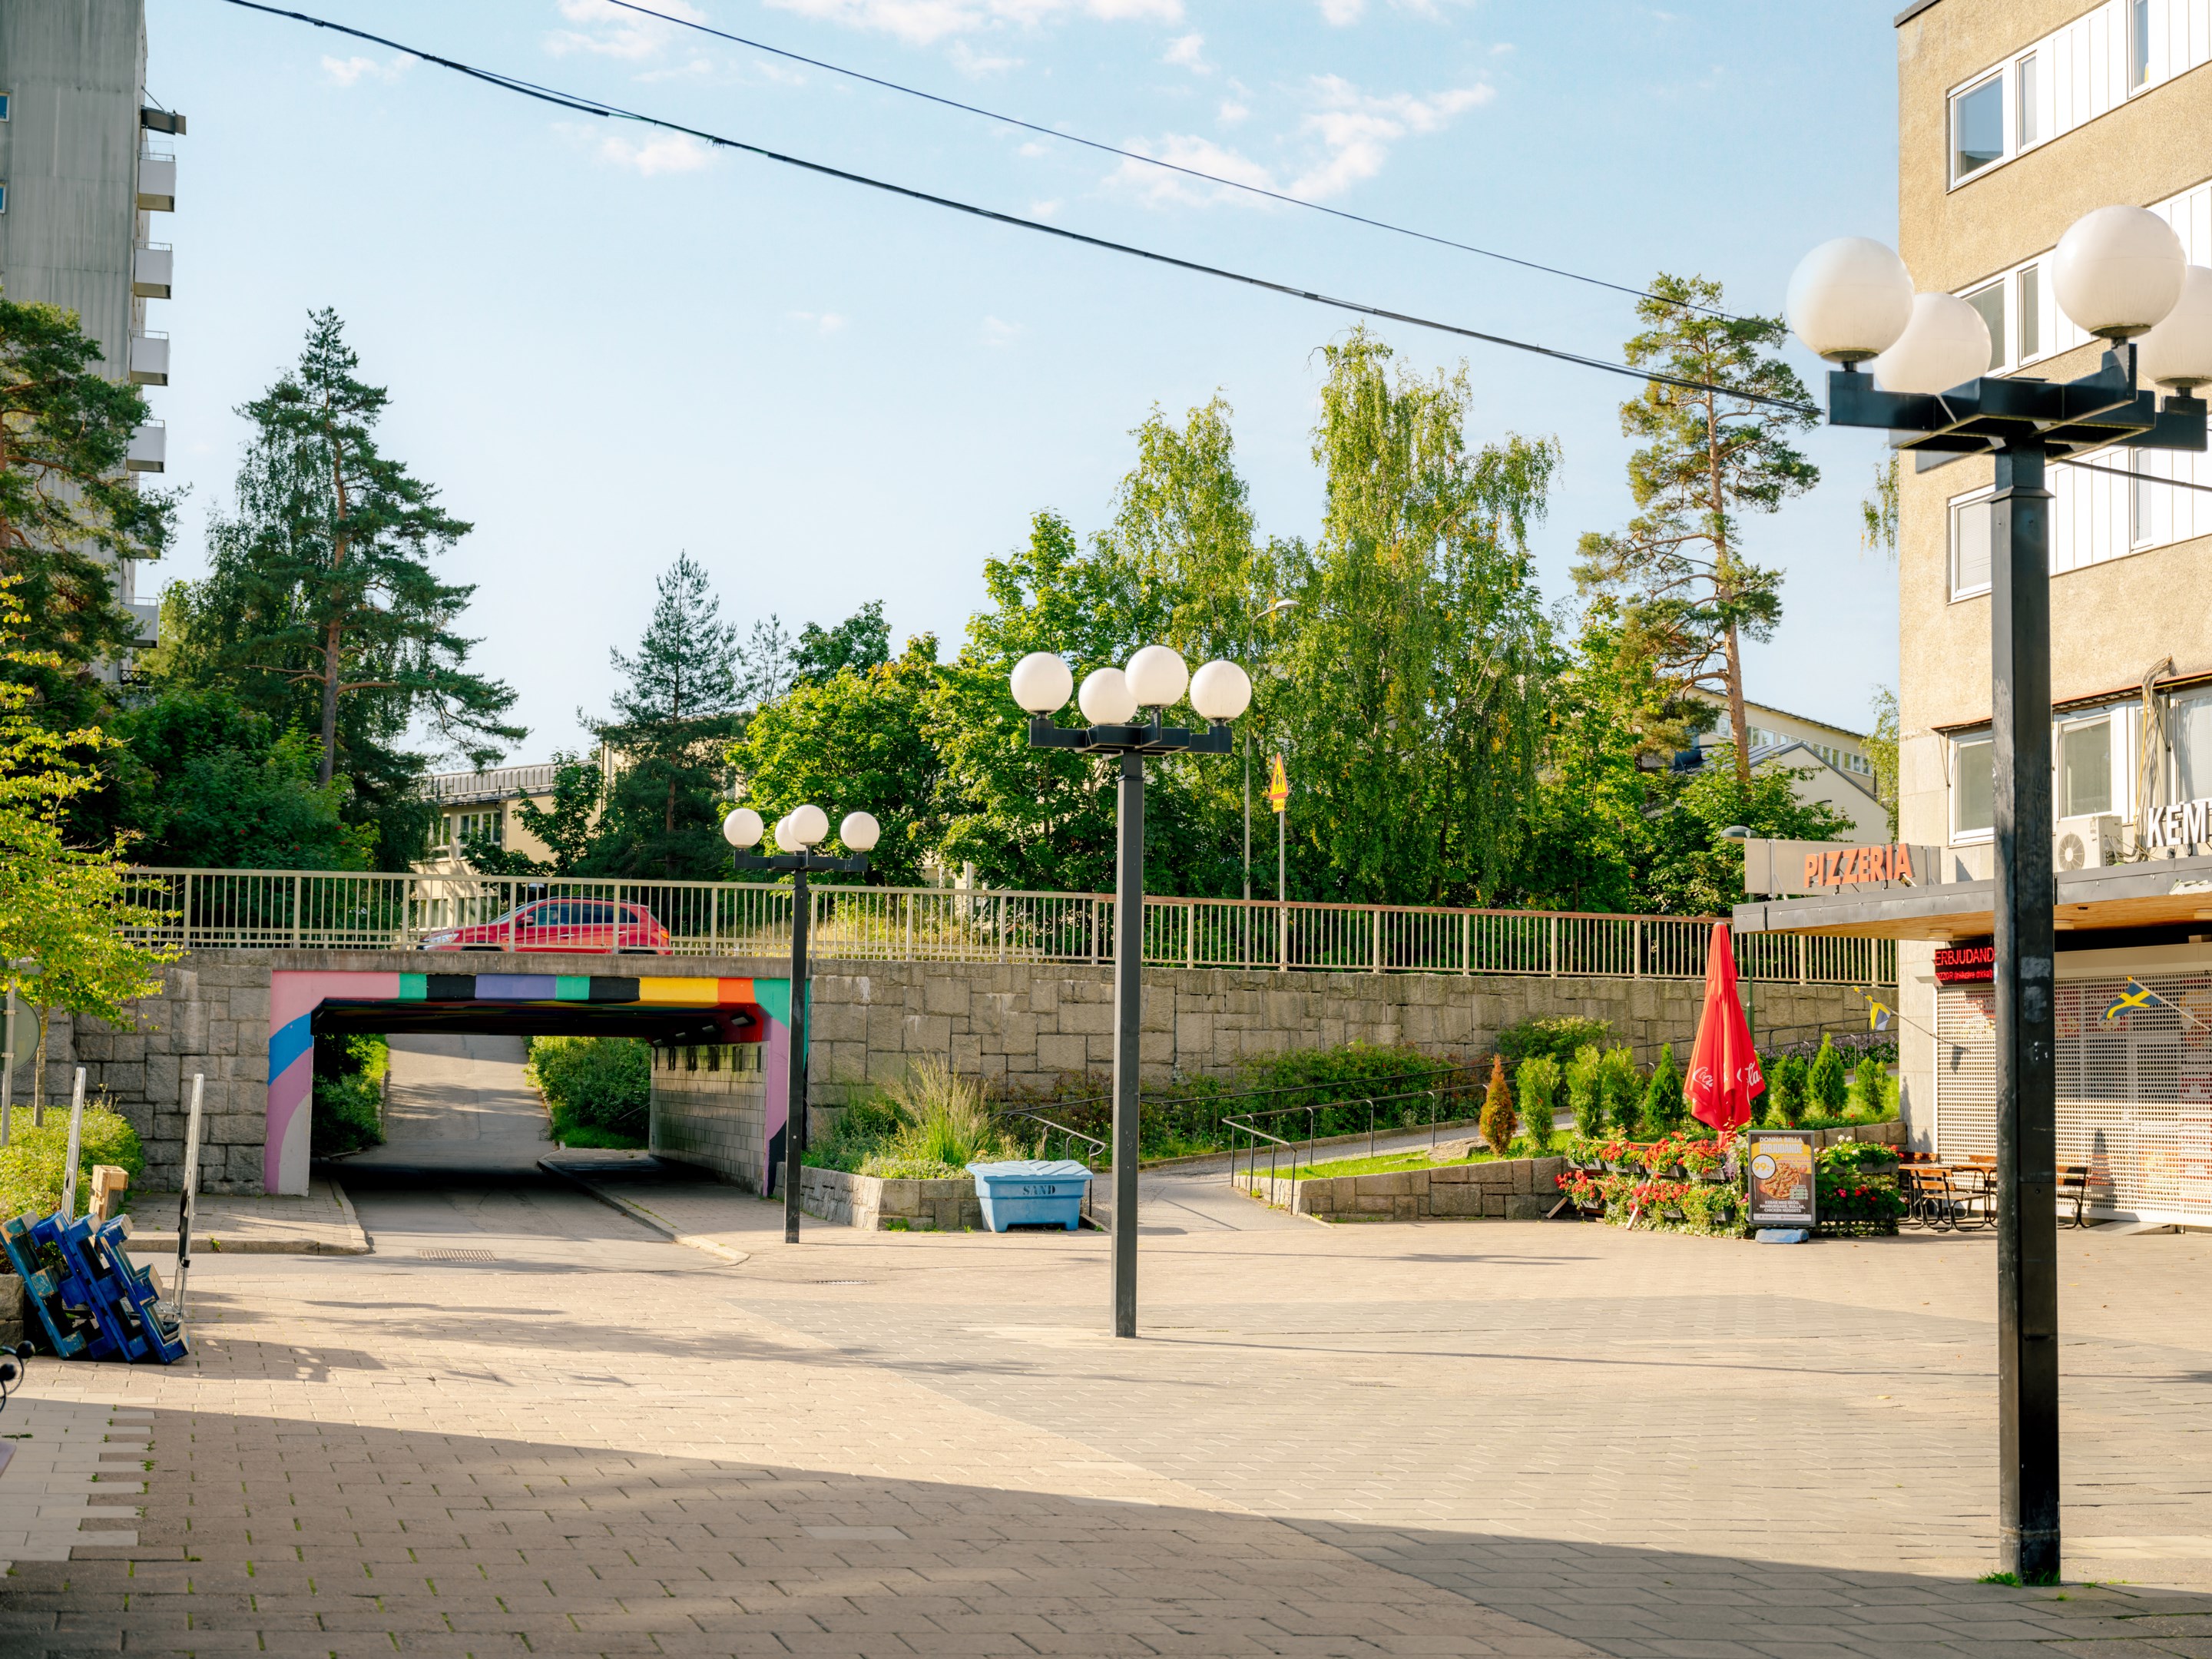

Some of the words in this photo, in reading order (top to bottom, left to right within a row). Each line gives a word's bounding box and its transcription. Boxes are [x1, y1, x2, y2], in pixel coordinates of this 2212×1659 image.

[2147, 801, 2212, 847] KEM
[1803, 843, 1914, 888] PIZZERIA
[1760, 1144, 1803, 1154] ERBJUDANDE
[1022, 1184, 1056, 1195] SAND
